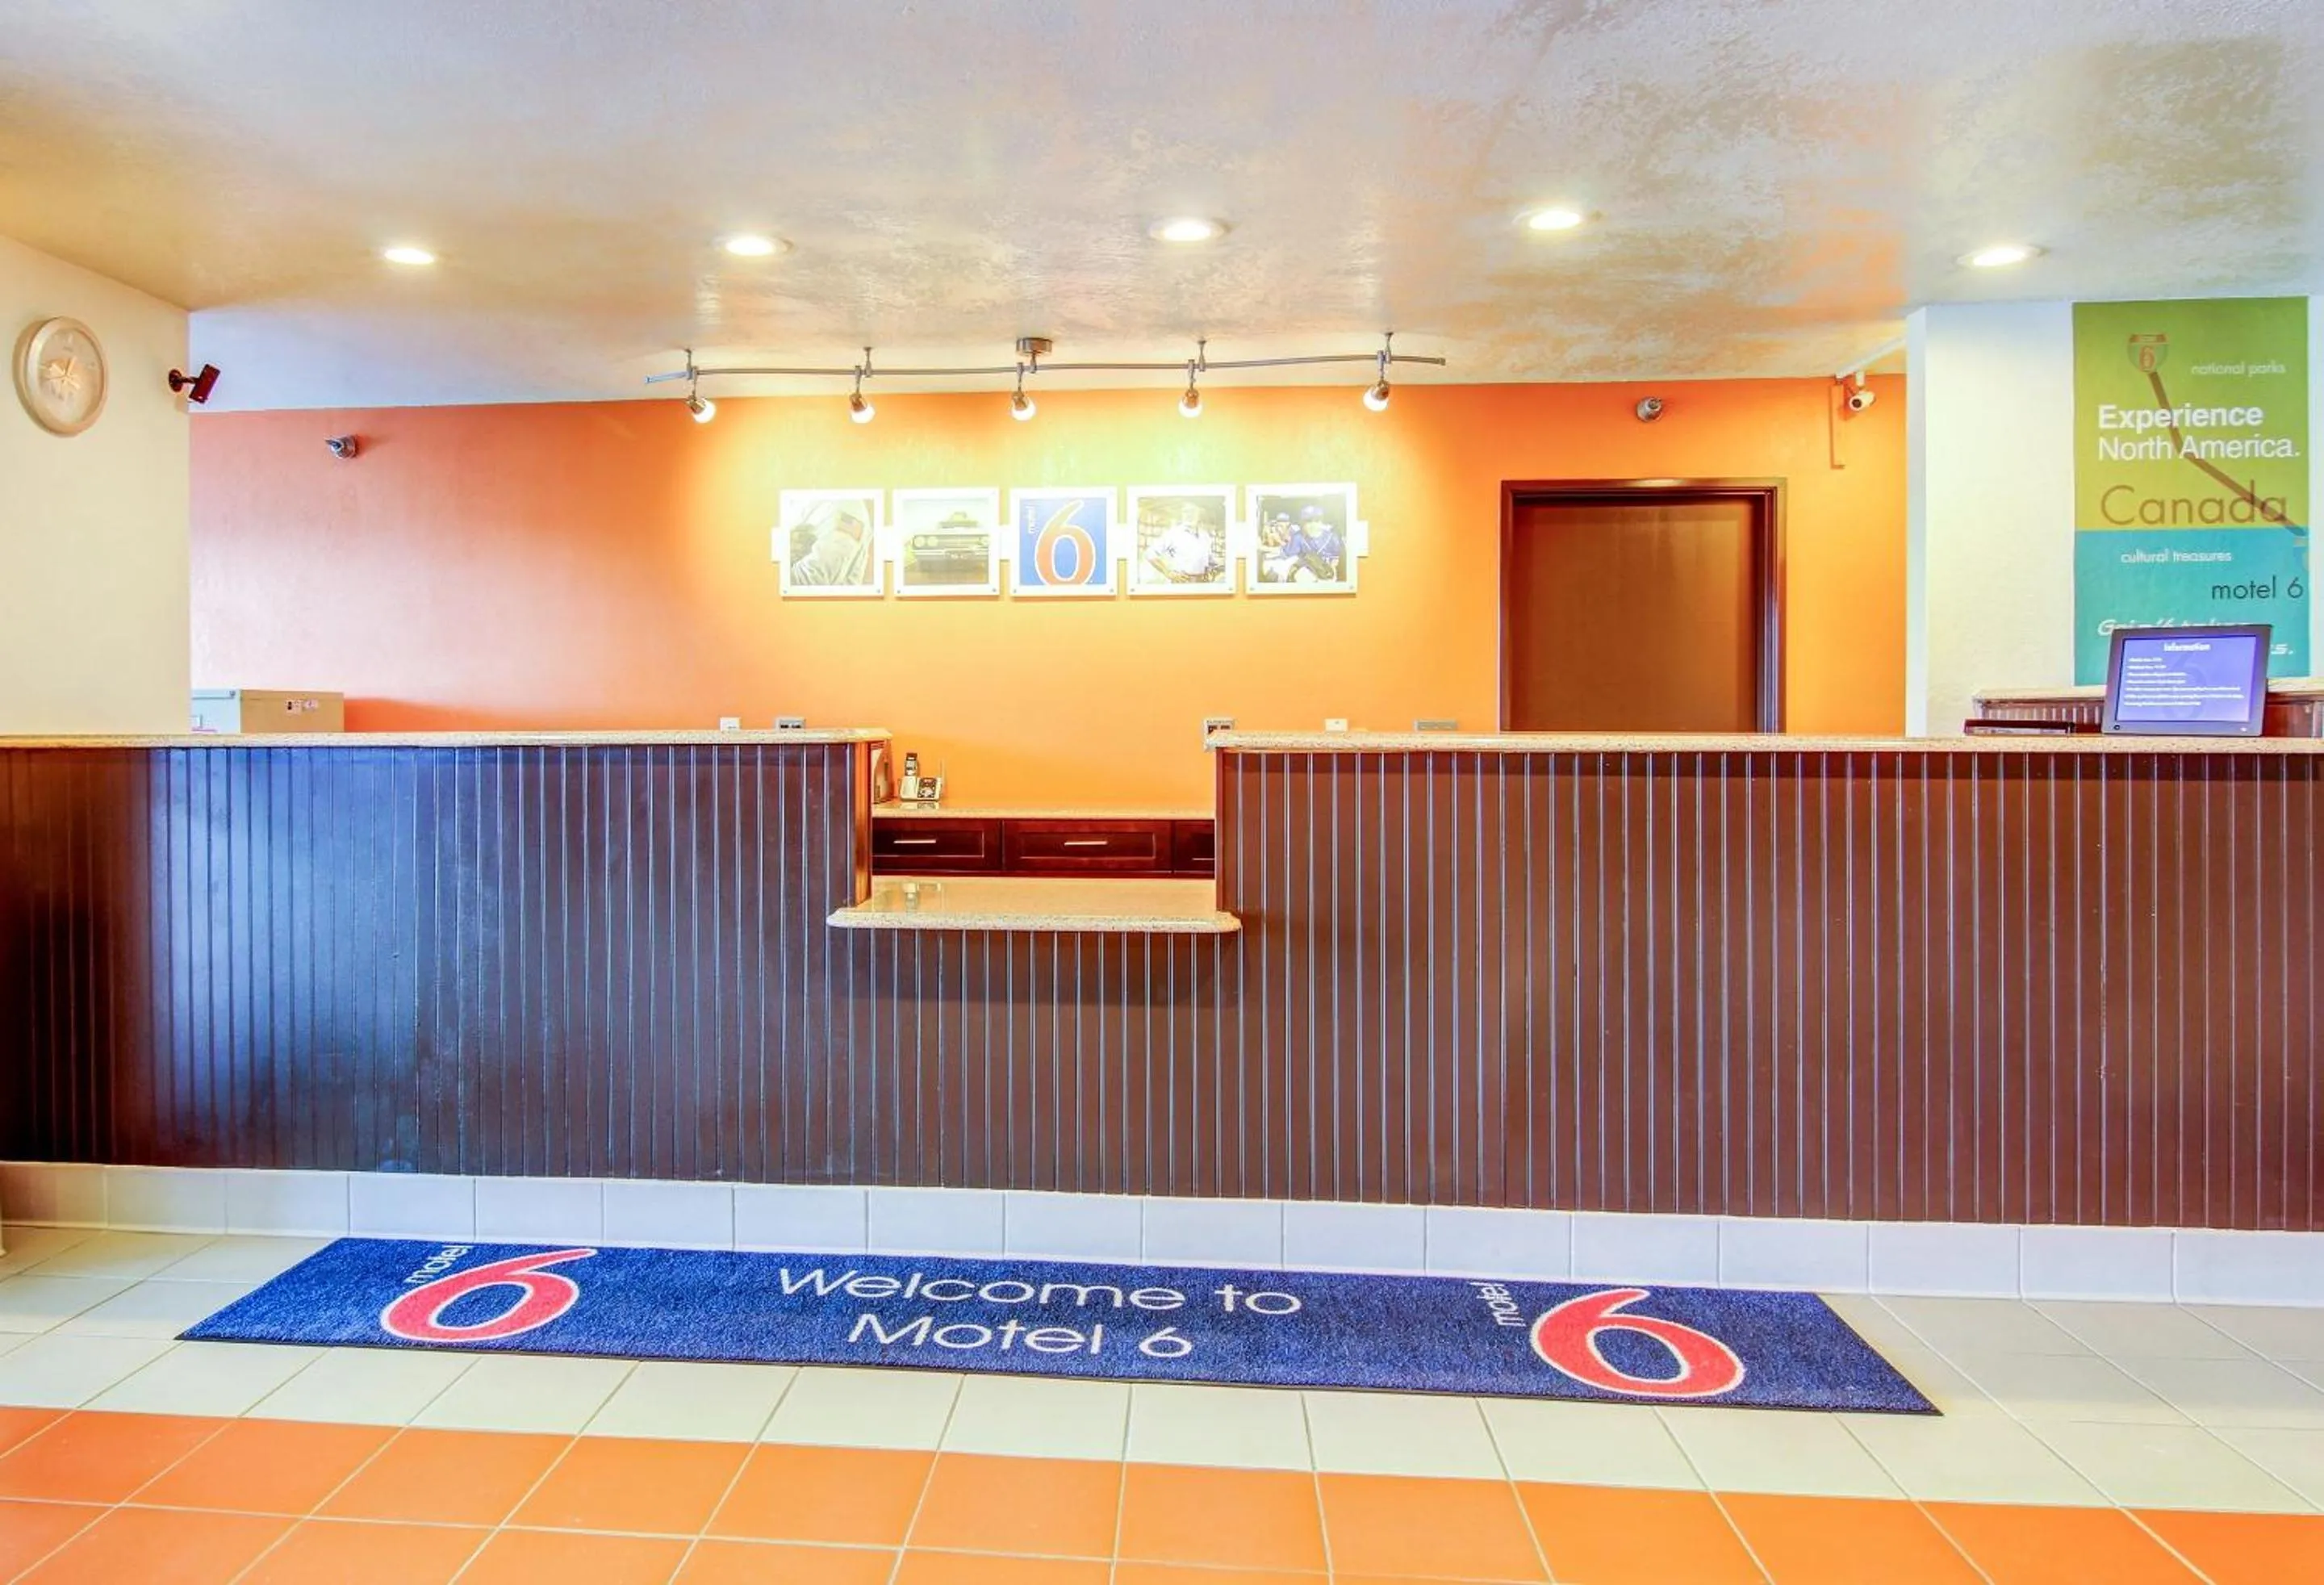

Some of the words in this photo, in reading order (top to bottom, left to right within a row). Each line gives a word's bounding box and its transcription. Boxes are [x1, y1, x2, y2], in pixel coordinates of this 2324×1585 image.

[2191, 361, 2245, 374] national
[2098, 404, 2263, 433] Experience
[2097, 436, 2172, 462] North
[2180, 434, 2300, 458] America.
[2100, 479, 2288, 525] Canada
[1034, 498, 1097, 585] 6
[2121, 549, 2169, 563] cultural
[2172, 549, 2233, 563] treasures
[2211, 575, 2277, 600] motel
[2287, 577, 2305, 600] 6
[2163, 642, 2212, 652] Information
[405, 1245, 474, 1283] motel
[379, 1247, 598, 1343] 6
[779, 1267, 1185, 1310] Welcome
[1214, 1283, 1303, 1315] to
[1469, 1282, 1527, 1328] motel
[847, 1312, 1102, 1355] Motel
[1138, 1327, 1193, 1358] 6
[1529, 1287, 1745, 1399] 6
